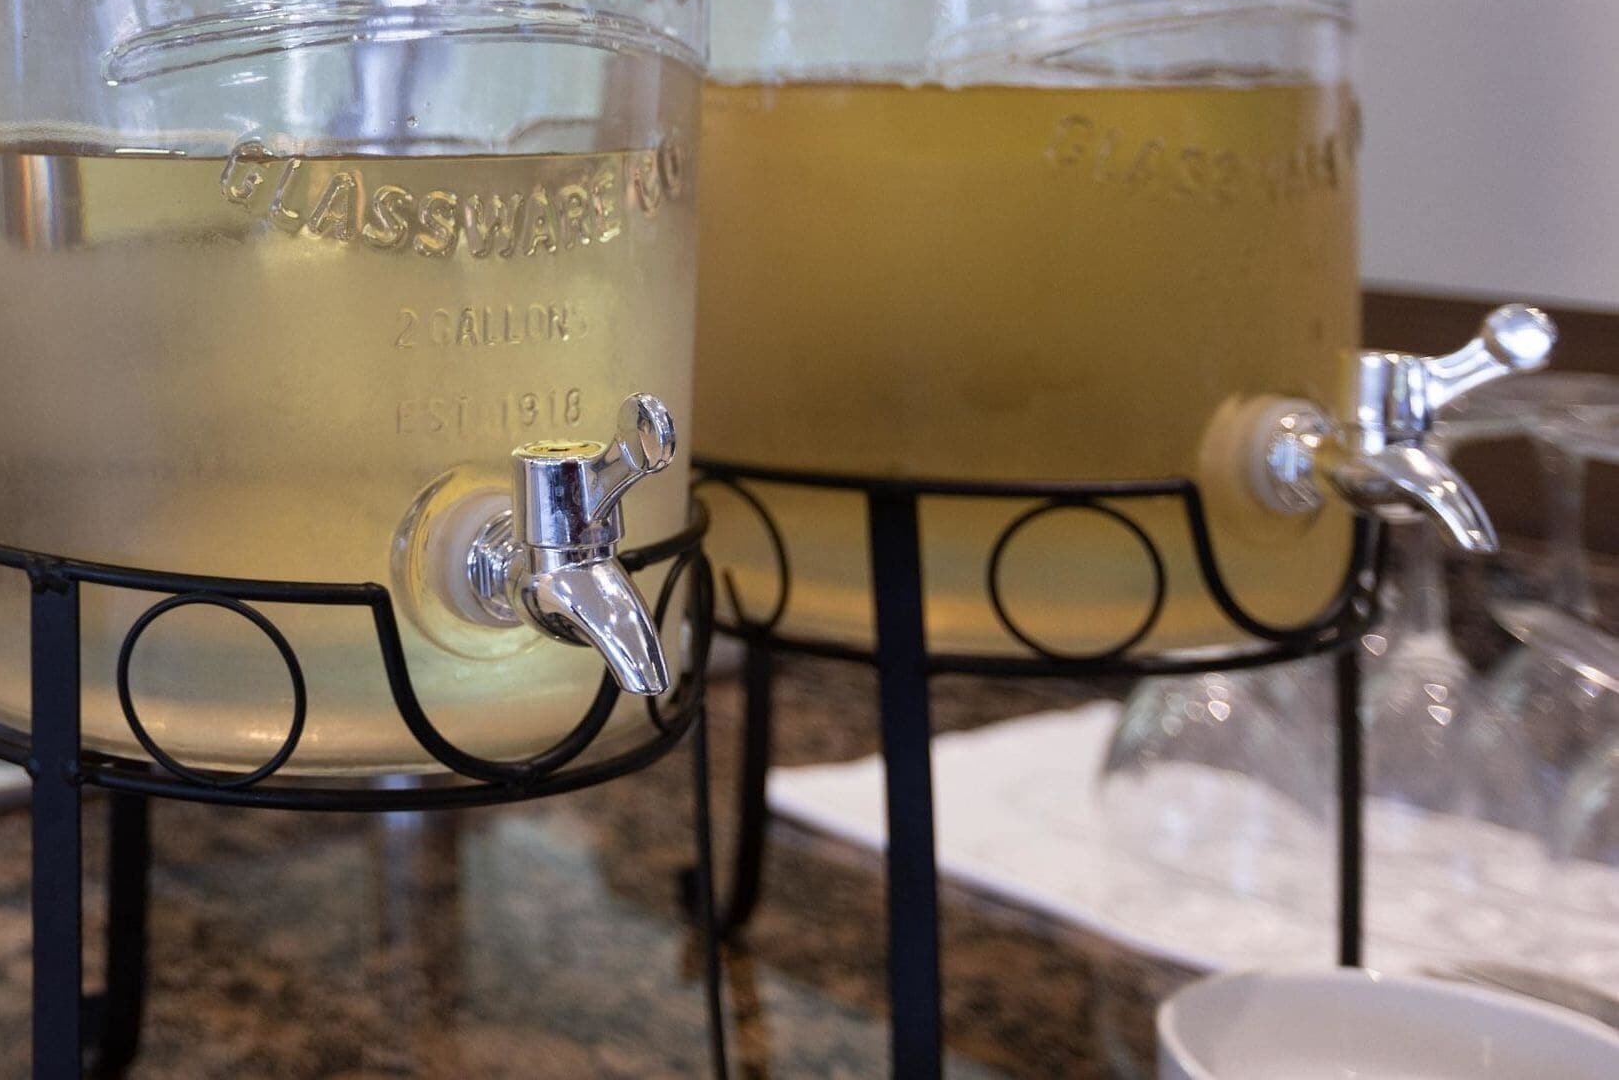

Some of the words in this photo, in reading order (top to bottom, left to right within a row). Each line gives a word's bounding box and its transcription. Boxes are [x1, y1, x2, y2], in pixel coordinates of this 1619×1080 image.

[220, 140, 621, 259] GLASSWARE
[393, 307, 418, 350] 2
[499, 386, 582, 435] 1918
